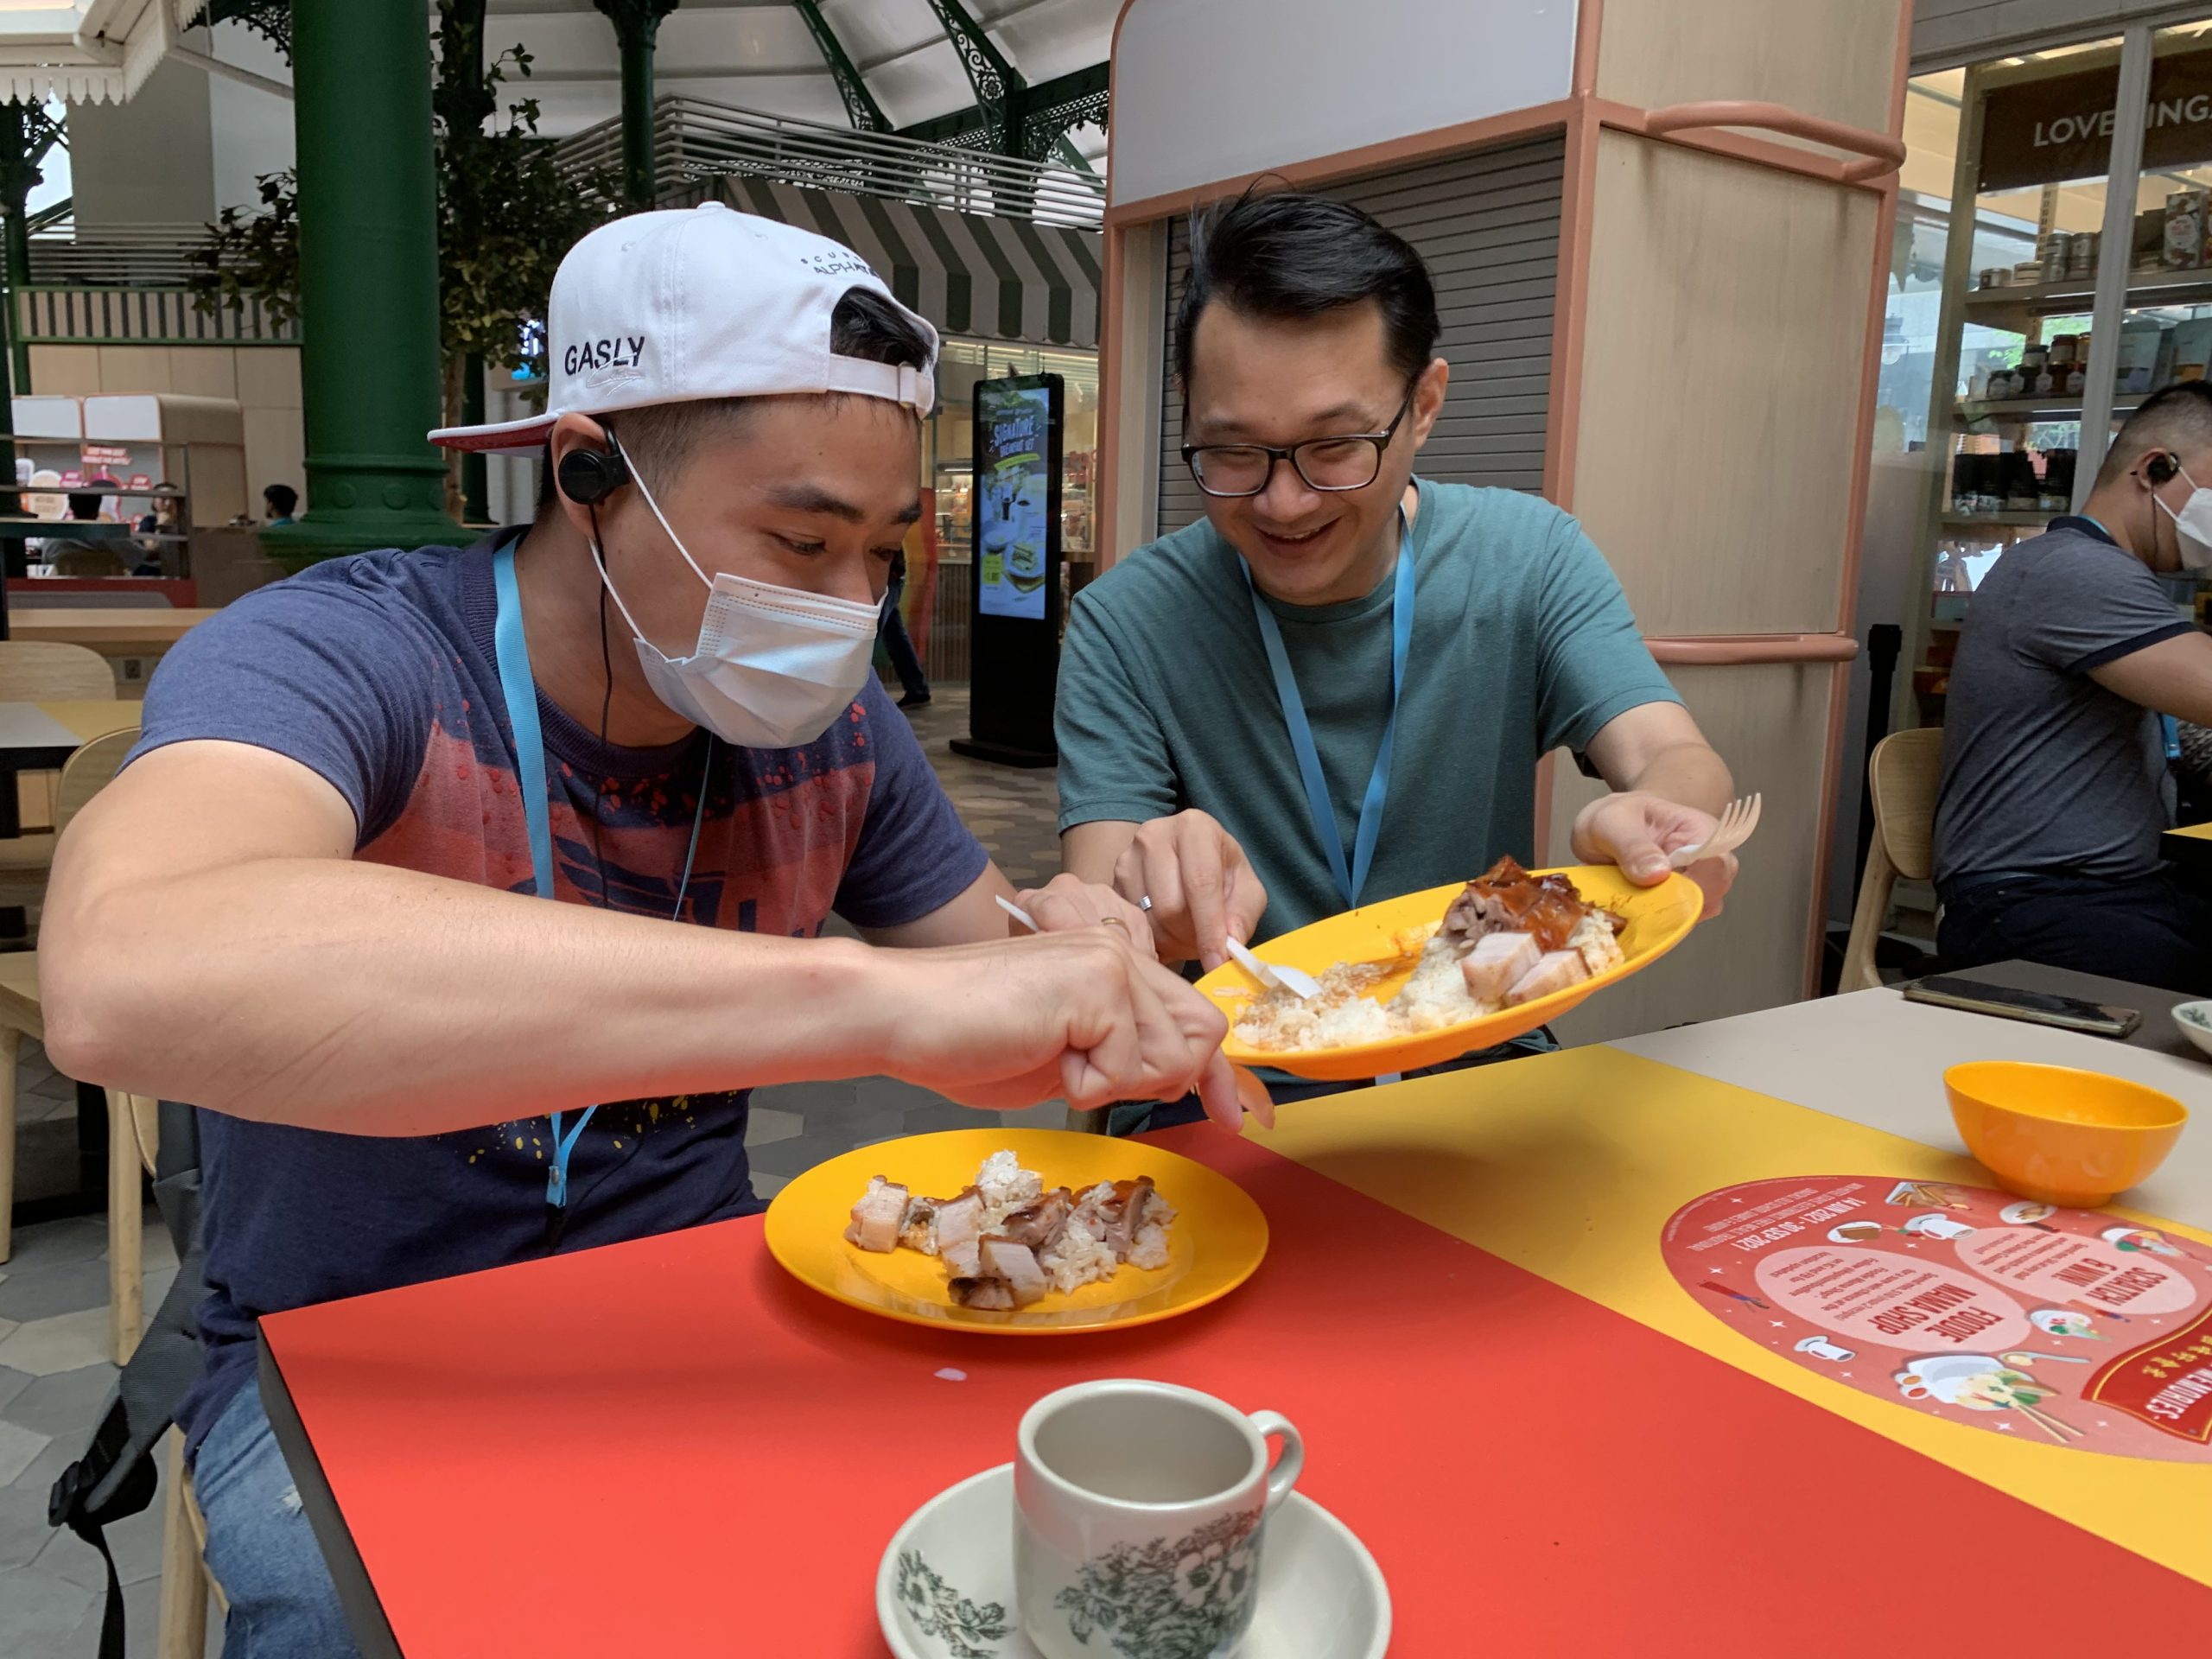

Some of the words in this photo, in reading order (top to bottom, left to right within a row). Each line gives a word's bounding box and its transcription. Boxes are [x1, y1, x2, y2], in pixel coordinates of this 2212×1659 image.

[564, 336, 645, 376] GASLY
[1823, 1202, 1854, 1212] JUN
[1840, 1197, 1867, 1206] 14
[1798, 1209, 1837, 1223] 2021
[1756, 1227, 1790, 1239] SEP
[1776, 1221, 1805, 1231] 30
[1728, 1235, 1770, 1250] 2021
[2081, 1257, 2119, 1271] &
[2085, 1267, 2165, 1306] SCRATCH
[1906, 1284, 1975, 1313] MAMA
[1862, 1306, 1929, 1334] SHOP
[1923, 1306, 2003, 1342] FOODIE
